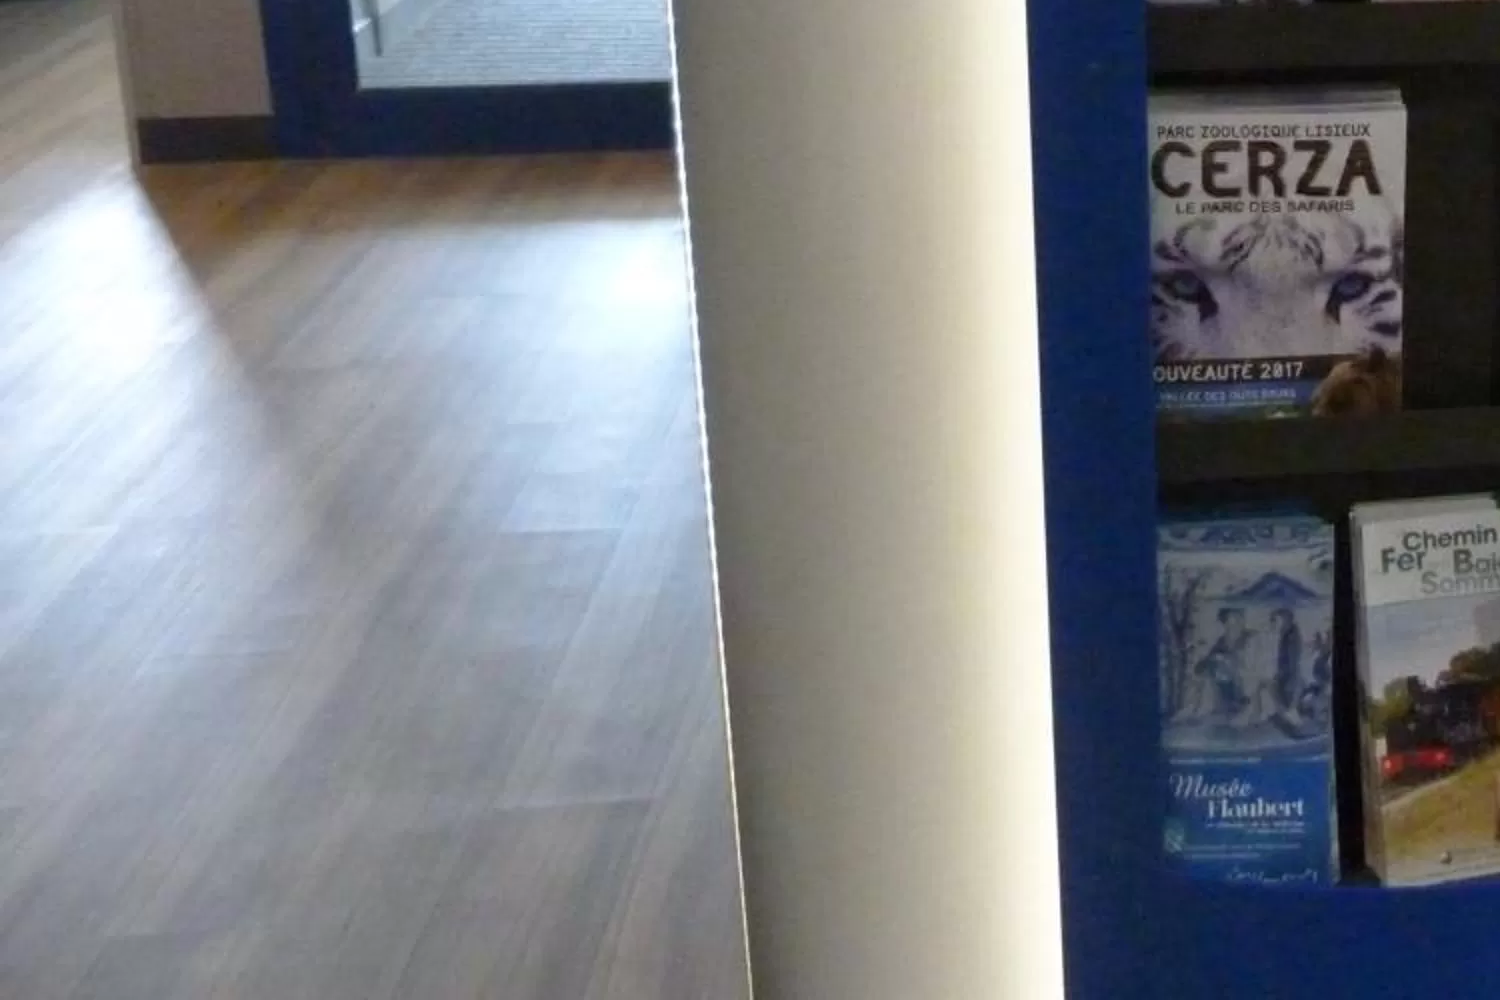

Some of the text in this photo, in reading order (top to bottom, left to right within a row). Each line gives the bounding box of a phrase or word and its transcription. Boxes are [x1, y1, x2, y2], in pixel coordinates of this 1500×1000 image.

[1157, 123, 1371, 139] PARC ZOOLOGIQUE LISIEUX
[1151, 140, 1382, 198] CERZA
[1176, 199, 1355, 214] LE PARC DES SAFARIS
[1259, 361, 1303, 379] 2017
[1402, 525, 1498, 551] Chemin
[1381, 547, 1426, 574] Fer
